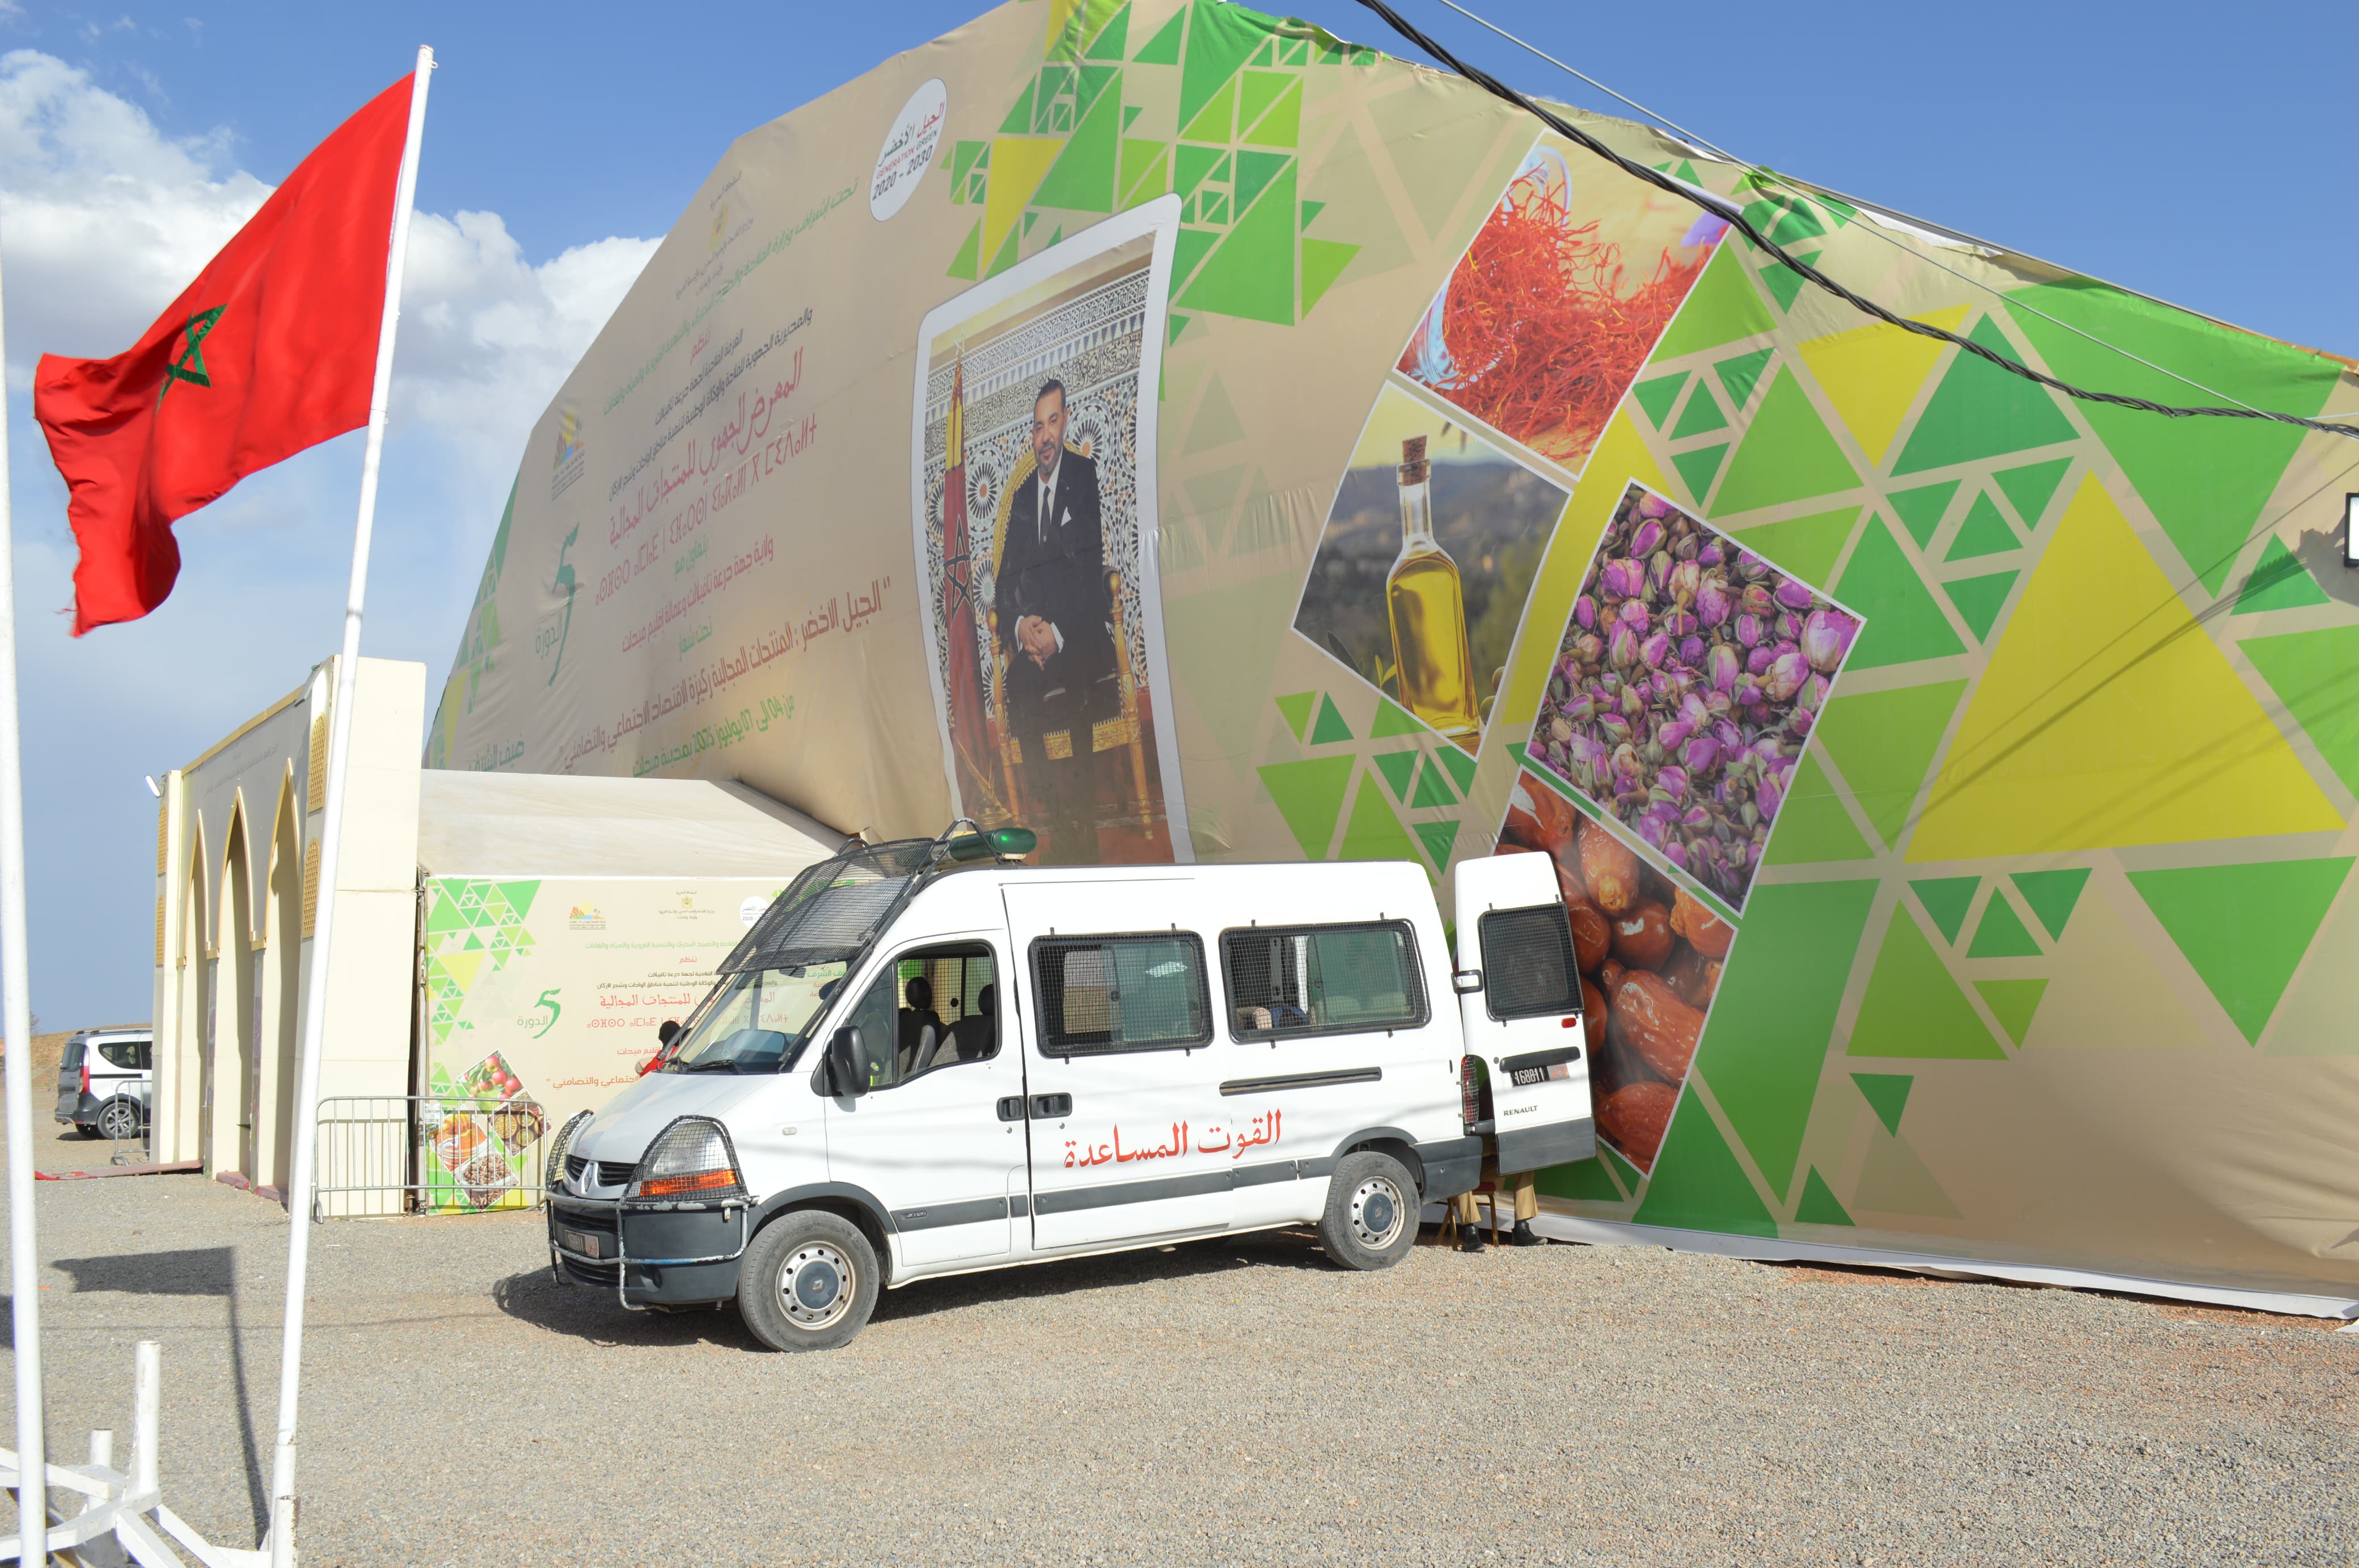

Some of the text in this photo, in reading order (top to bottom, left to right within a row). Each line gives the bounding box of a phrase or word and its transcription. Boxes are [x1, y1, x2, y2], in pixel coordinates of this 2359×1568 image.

[916, 128, 938, 150] GREEN
[872, 171, 897, 201] 2020
[907, 145, 933, 176] 2030
[831, 176, 859, 209] تحت
[775, 307, 813, 346] والمديرية
[746, 333, 775, 369] الجهوية
[737, 346, 803, 455] المعرض
[646, 438, 695, 513] للمنتجات
[610, 487, 644, 550] المجالية
[734, 554, 752, 575] جهة
[754, 534, 773, 566] ولاية
[713, 565, 733, 590] درعة
[801, 597, 839, 652] الأخضر
[843, 580, 882, 633] الجيل
[749, 621, 794, 670] المنتجات
[689, 667, 713, 705] ركيزة
[712, 646, 750, 692] المجالية
[652, 679, 688, 721] الاقتصاد
[767, 696, 784, 719] 04
[783, 694, 795, 720] من
[607, 700, 650, 754] الاجتماعي
[739, 709, 754, 731] 07
[565, 725, 606, 773] والتضامني
[532, 988, 561, 1039] 5
[600, 994, 638, 1009] المجالية
[642, 993, 690, 1007] للمنتجات
[517, 1016, 548, 1029] الدورة
[553, 1077, 599, 1089] والتضامني
[1503, 1105, 1538, 1117] RENAULT
[1063, 1119, 1189, 1168] المساعدة
